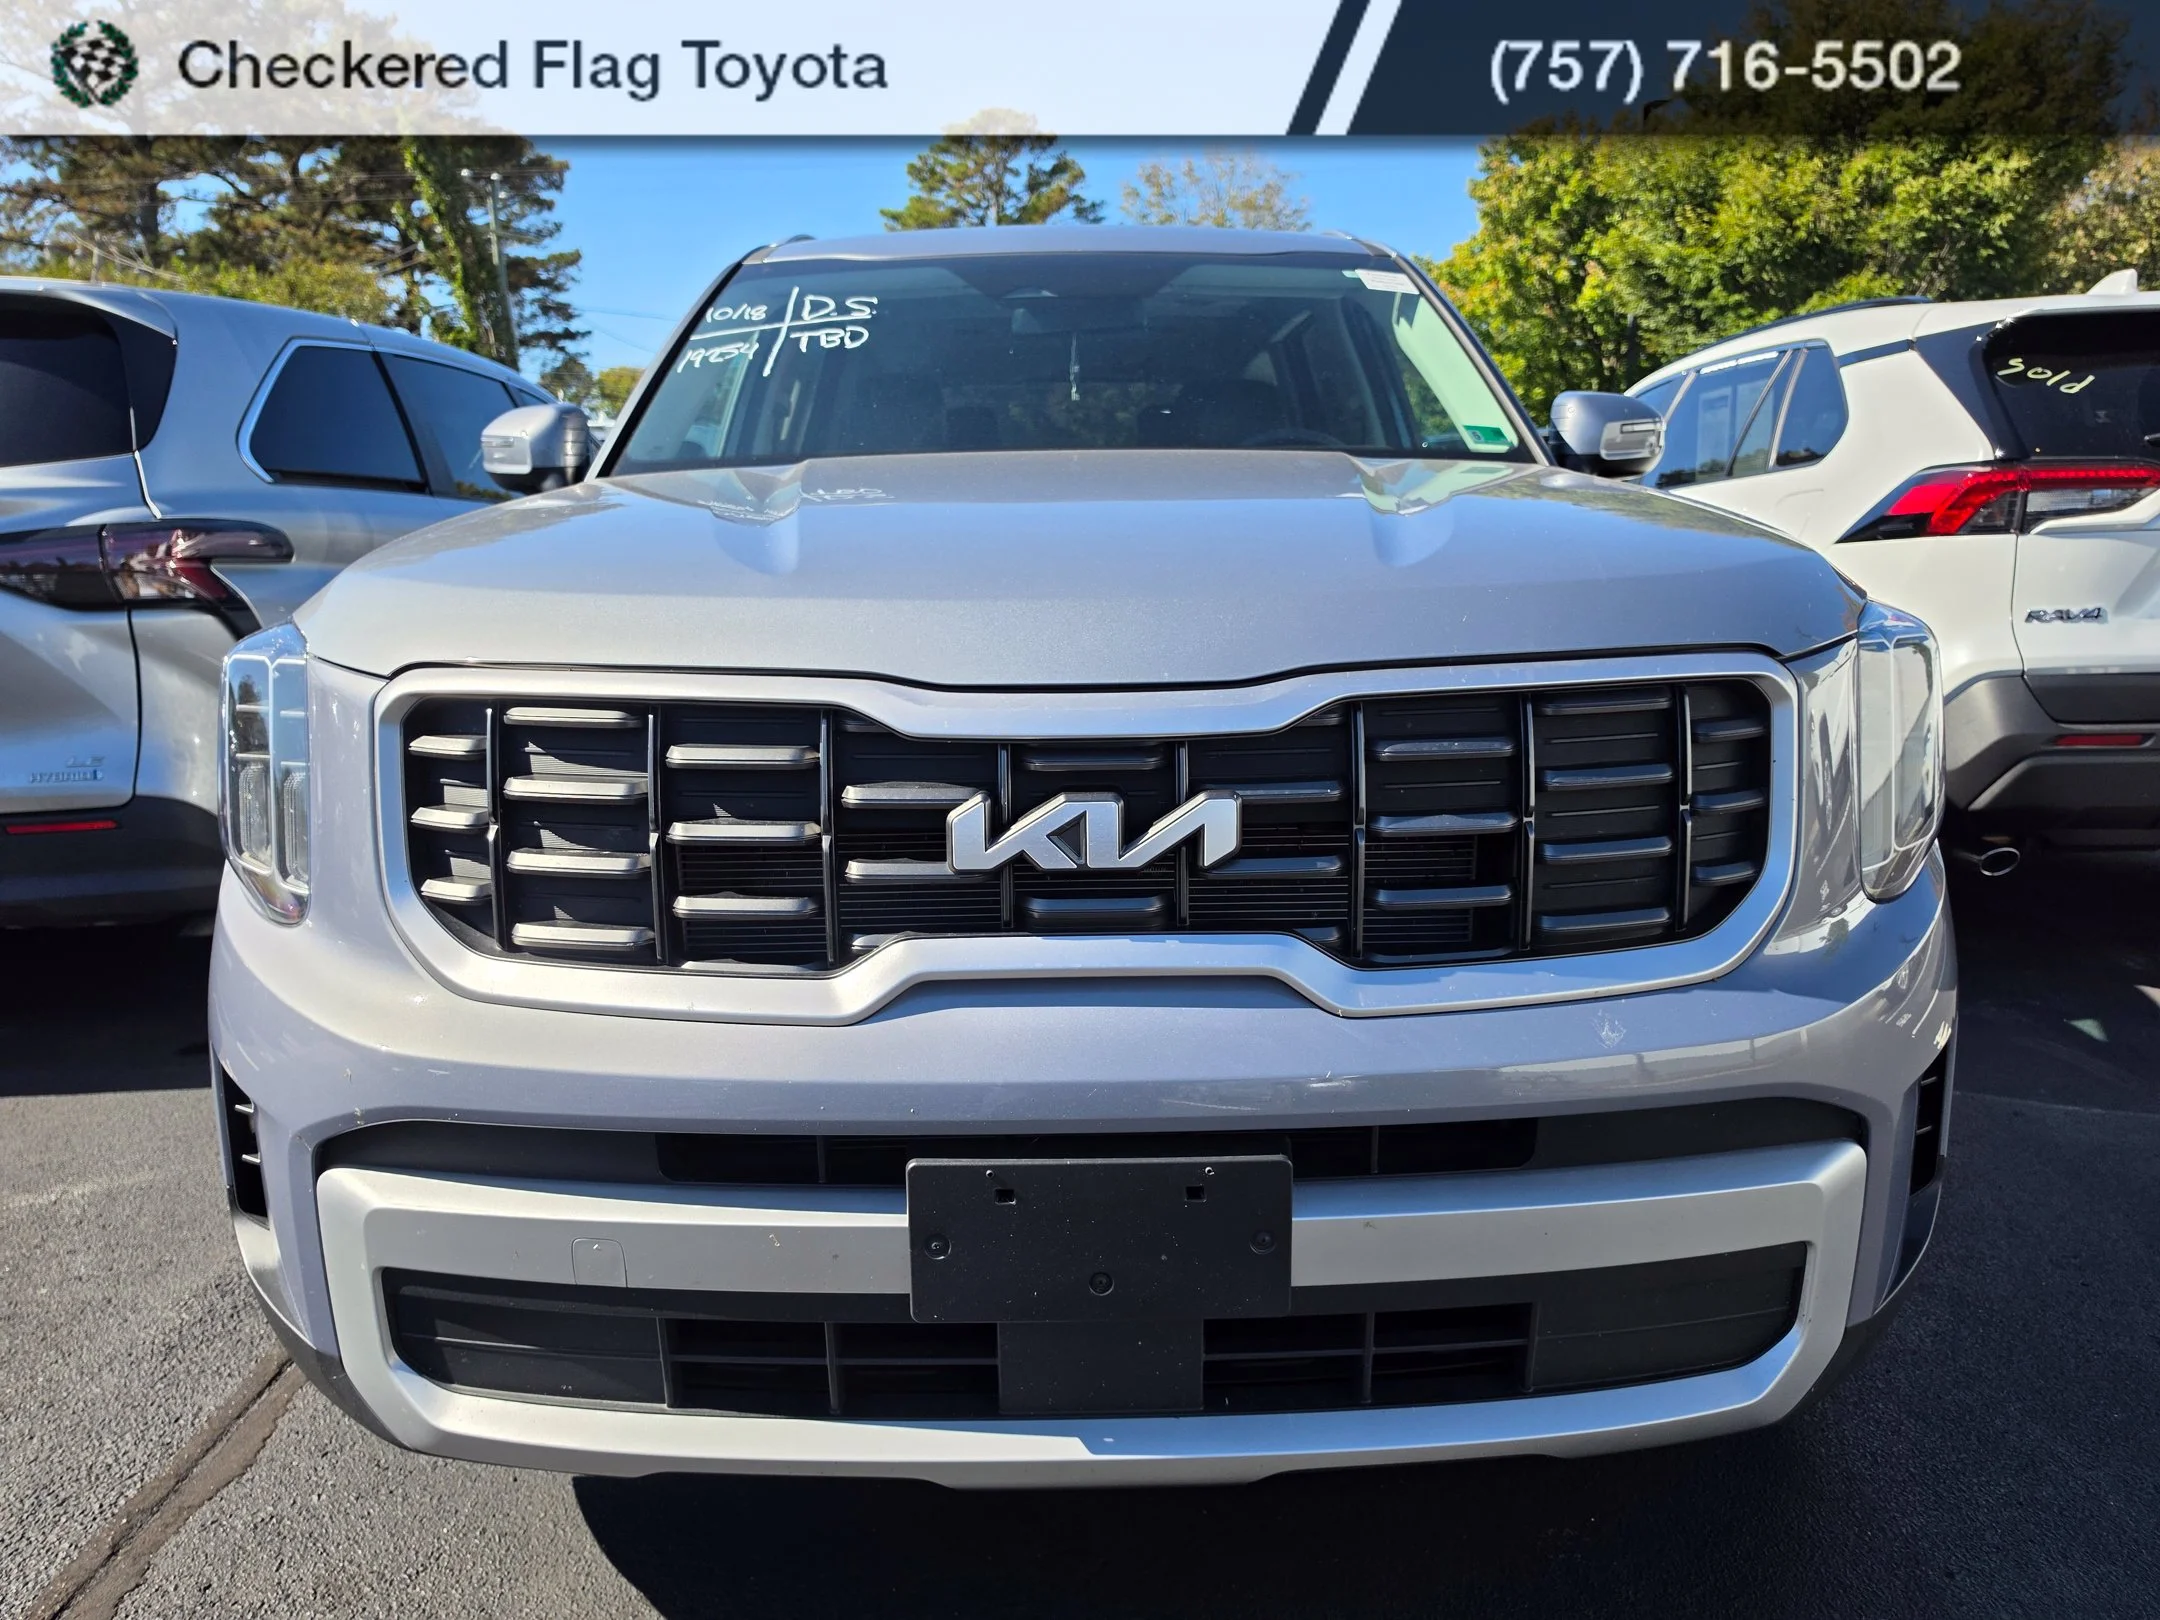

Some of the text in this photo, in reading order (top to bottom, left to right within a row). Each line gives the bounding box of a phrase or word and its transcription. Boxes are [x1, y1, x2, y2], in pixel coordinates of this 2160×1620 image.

[704, 303, 768, 323] 10/18
[789, 325, 869, 352] TBD
[2024, 606, 2108, 625] RAV4
[30, 768, 104, 783] HYBRID
[946, 790, 1243, 873] KIA
